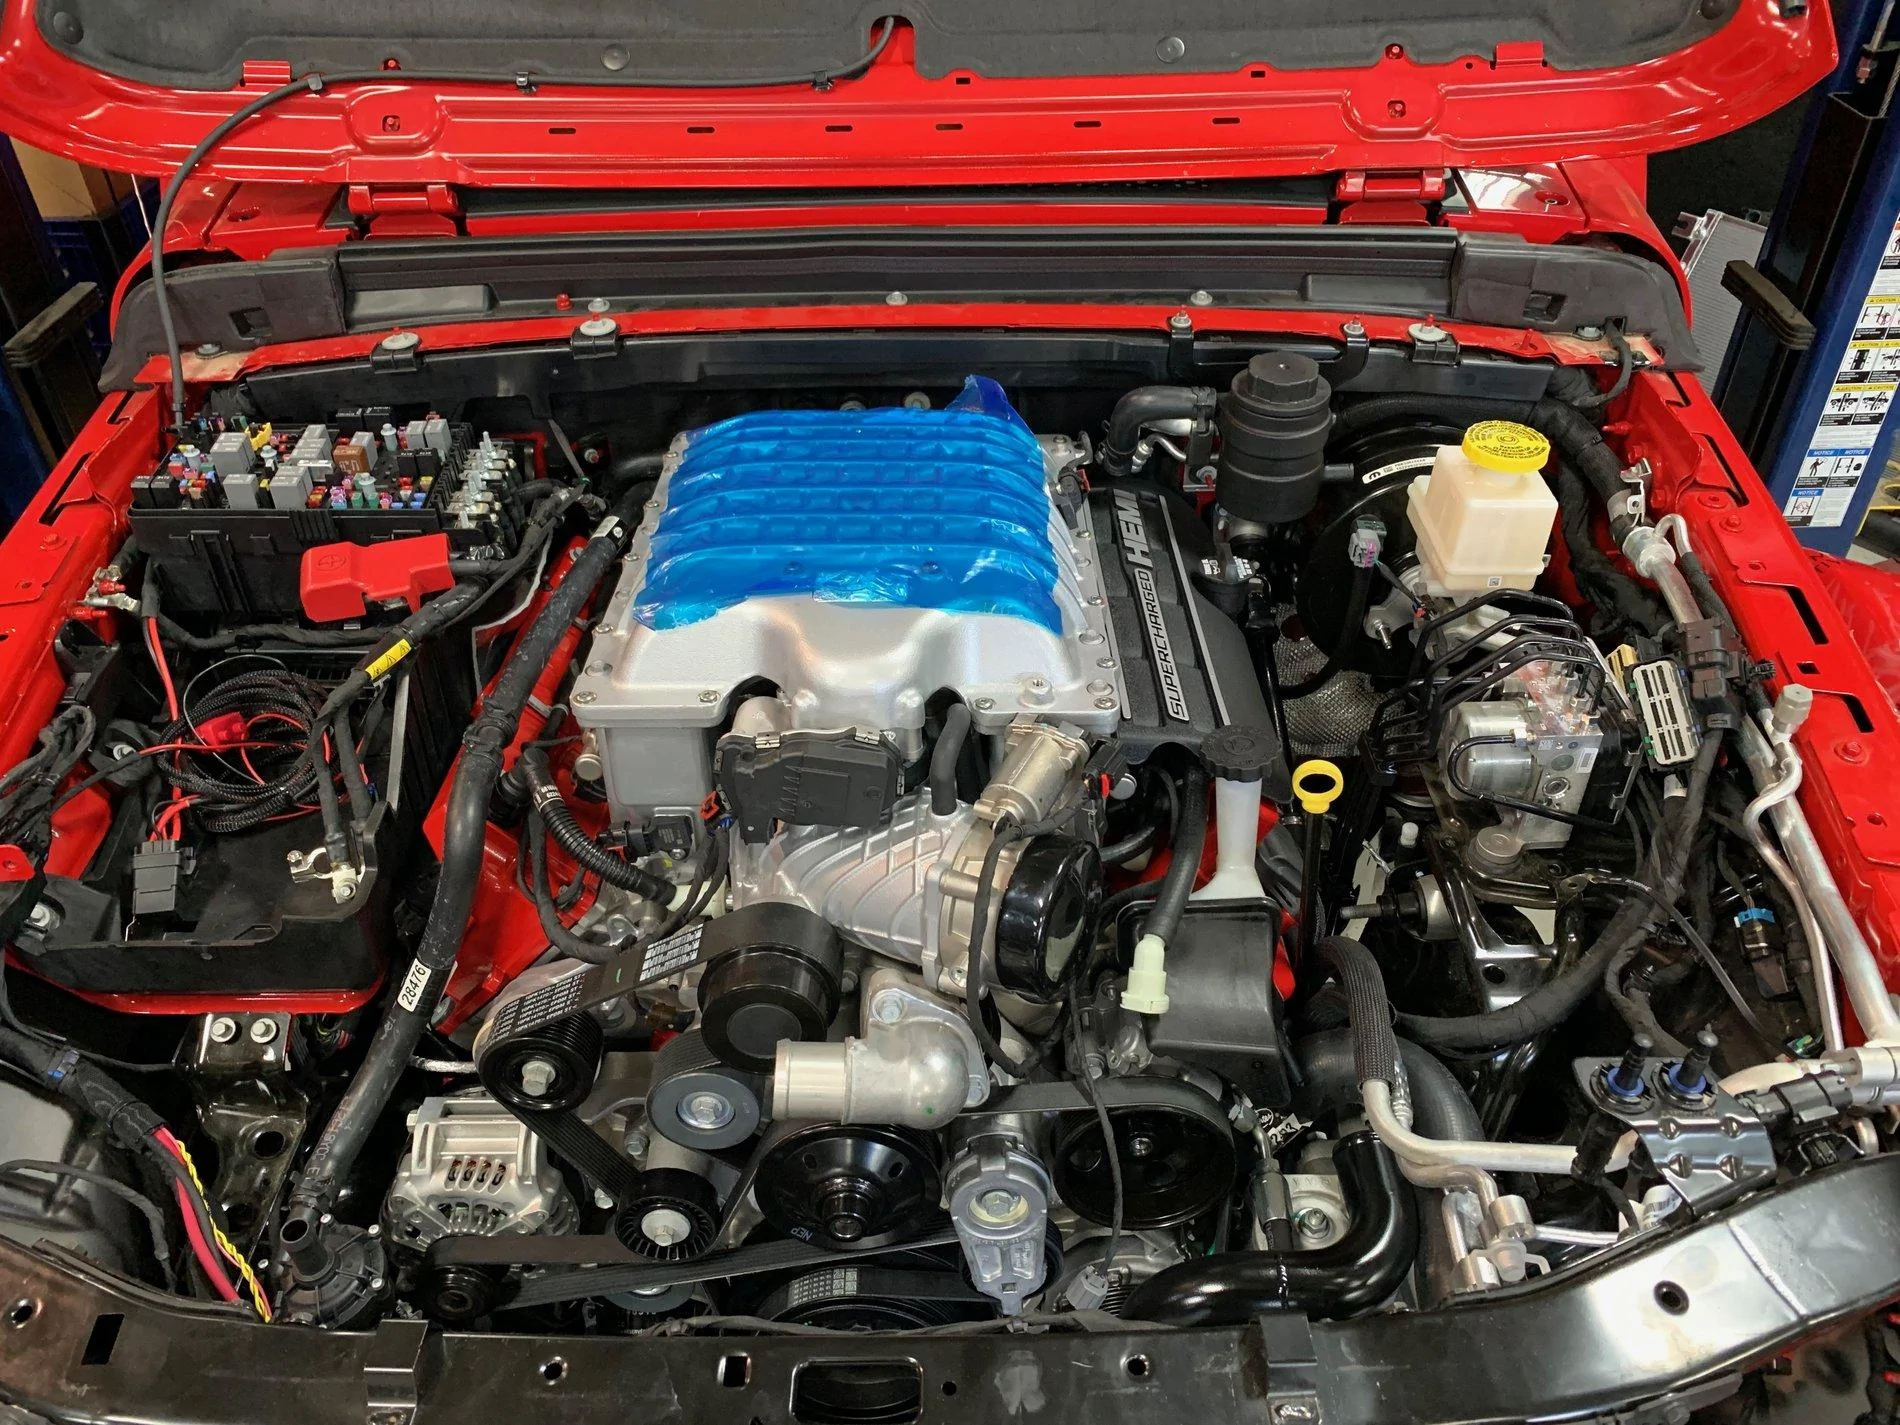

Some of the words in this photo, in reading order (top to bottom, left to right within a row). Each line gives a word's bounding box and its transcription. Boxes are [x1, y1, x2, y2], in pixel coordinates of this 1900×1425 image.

[1113, 488, 1154, 568] HEMI
[1138, 570, 1185, 718] SUPERCHARGED
[401, 964, 427, 1006] 28476
